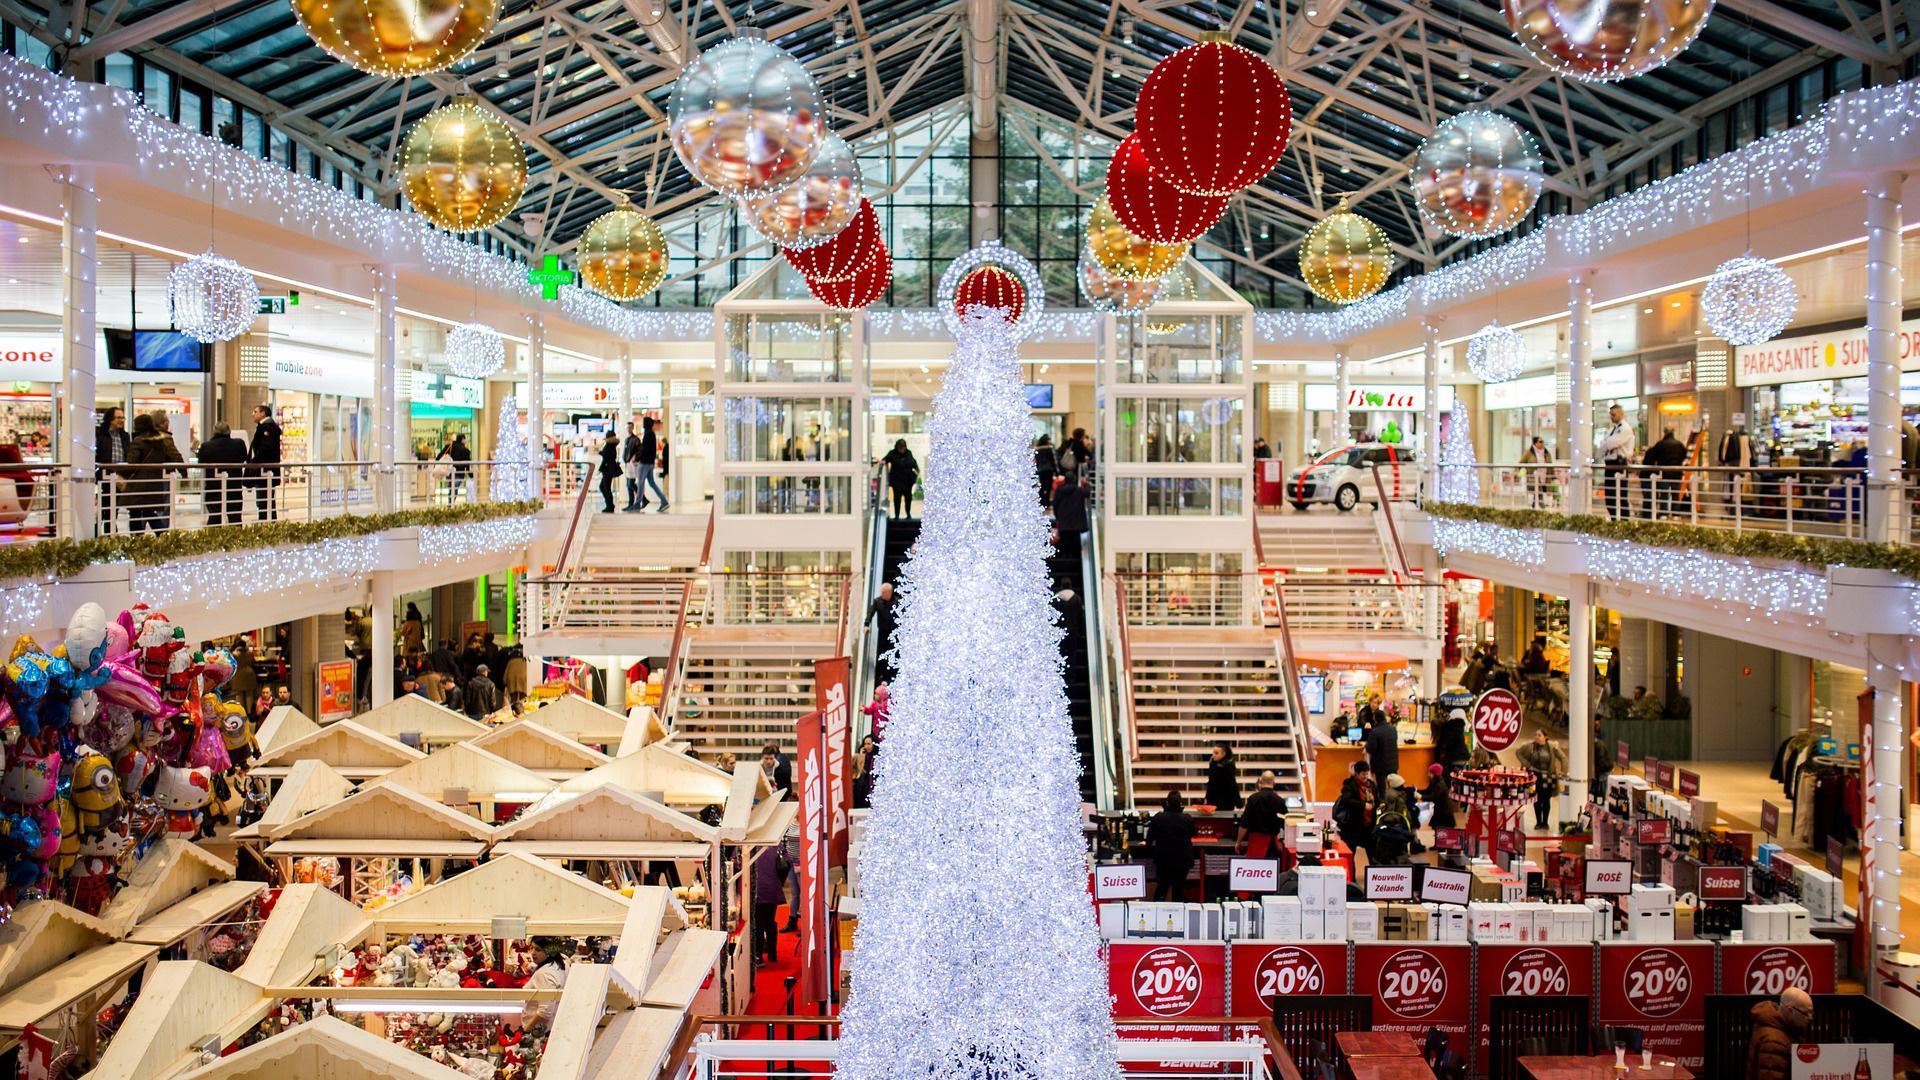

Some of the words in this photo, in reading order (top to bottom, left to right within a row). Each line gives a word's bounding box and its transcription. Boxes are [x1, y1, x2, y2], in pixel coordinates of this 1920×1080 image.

[528, 274, 572, 283] VICTORIA
[0, 351, 53, 362] one
[1743, 341, 1819, 375] PARASANTÉ
[275, 360, 323, 377] mobilezone
[1476, 705, 1520, 733] 20%
[1235, 866, 1273, 879] France
[1371, 873, 1408, 882] Nouvelle-
[1102, 875, 1138, 887] Suisse
[1374, 883, 1405, 893] Zélande
[1427, 879, 1466, 893] Australie
[1705, 876, 1741, 889] Suisse
[1137, 964, 1197, 997] 20%
[1260, 964, 1320, 997] 20%
[1383, 966, 1443, 999] 20%
[1506, 965, 1566, 995] 20%
[1629, 965, 1688, 998] 20%
[1750, 964, 1808, 995] 20%
[1406, 1024, 1421, 1032] und
[1422, 1024, 1466, 1033] prfitieren!
